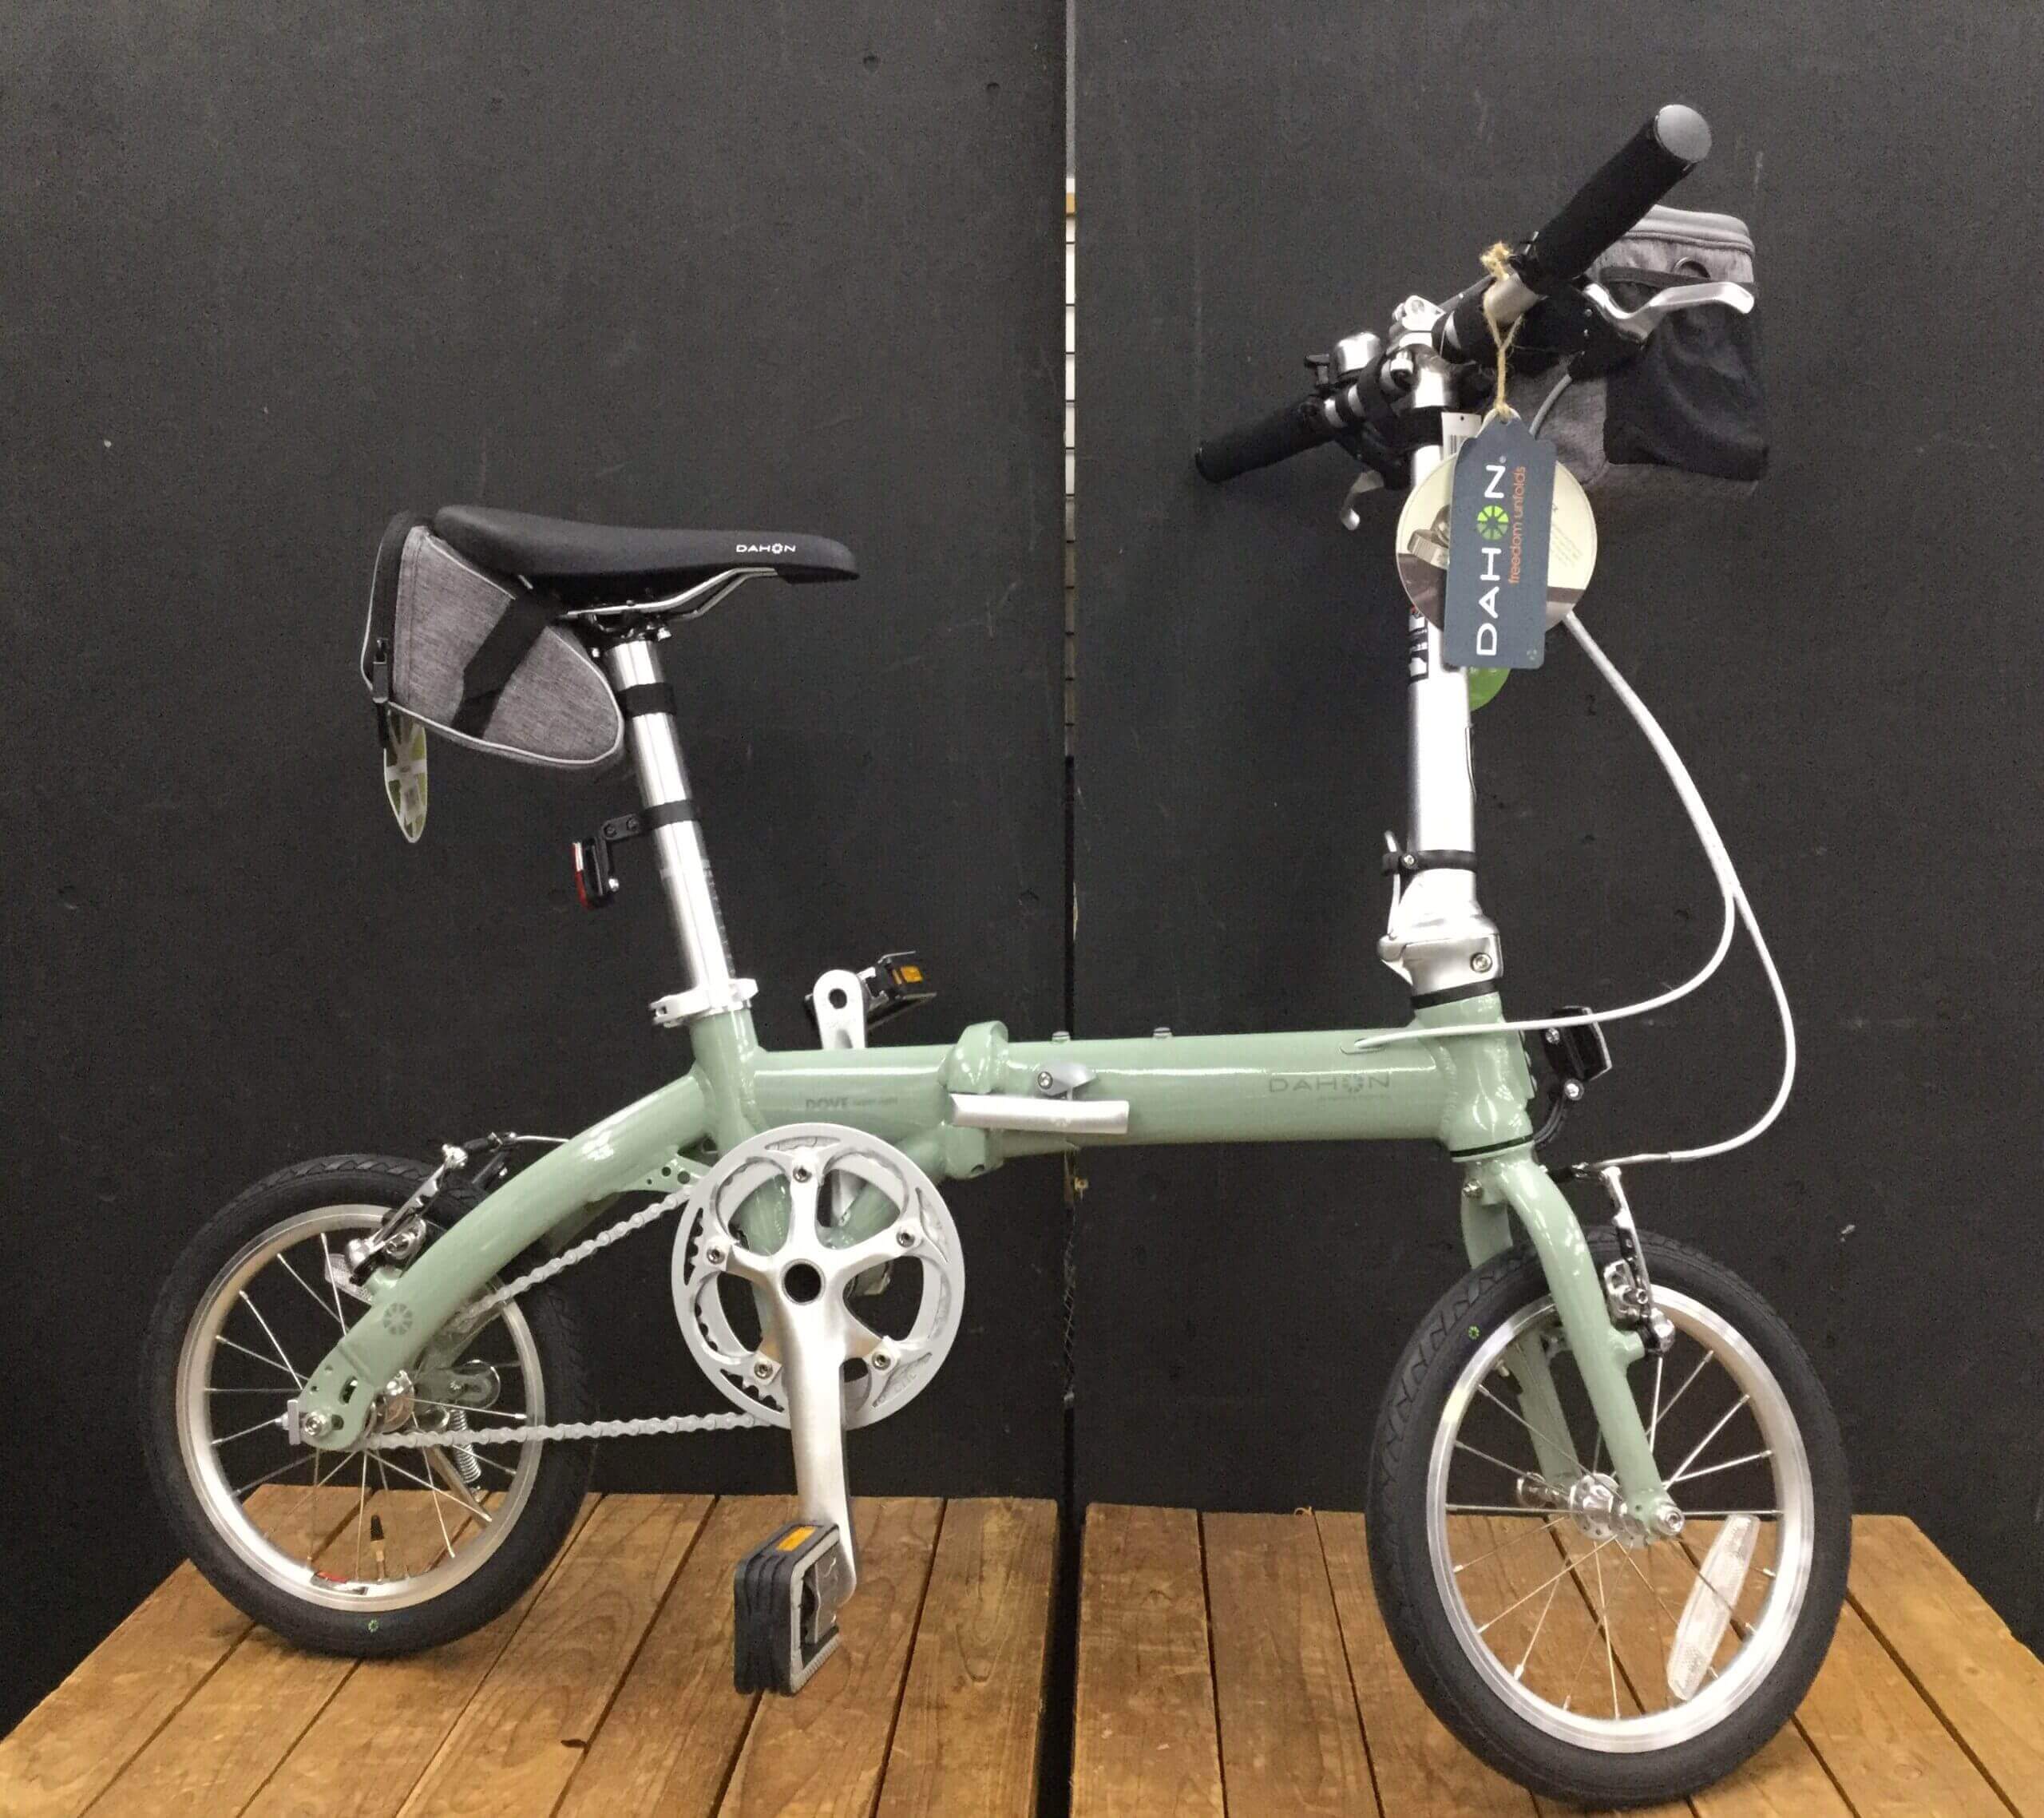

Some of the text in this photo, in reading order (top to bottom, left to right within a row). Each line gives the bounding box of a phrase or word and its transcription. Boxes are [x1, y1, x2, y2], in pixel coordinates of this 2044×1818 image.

[736, 543, 797, 554] DAHON
[1507, 465, 1527, 584] freedom unfolds
[1476, 464, 1510, 656] DAHON
[1269, 1074, 1391, 1093] DAHON
